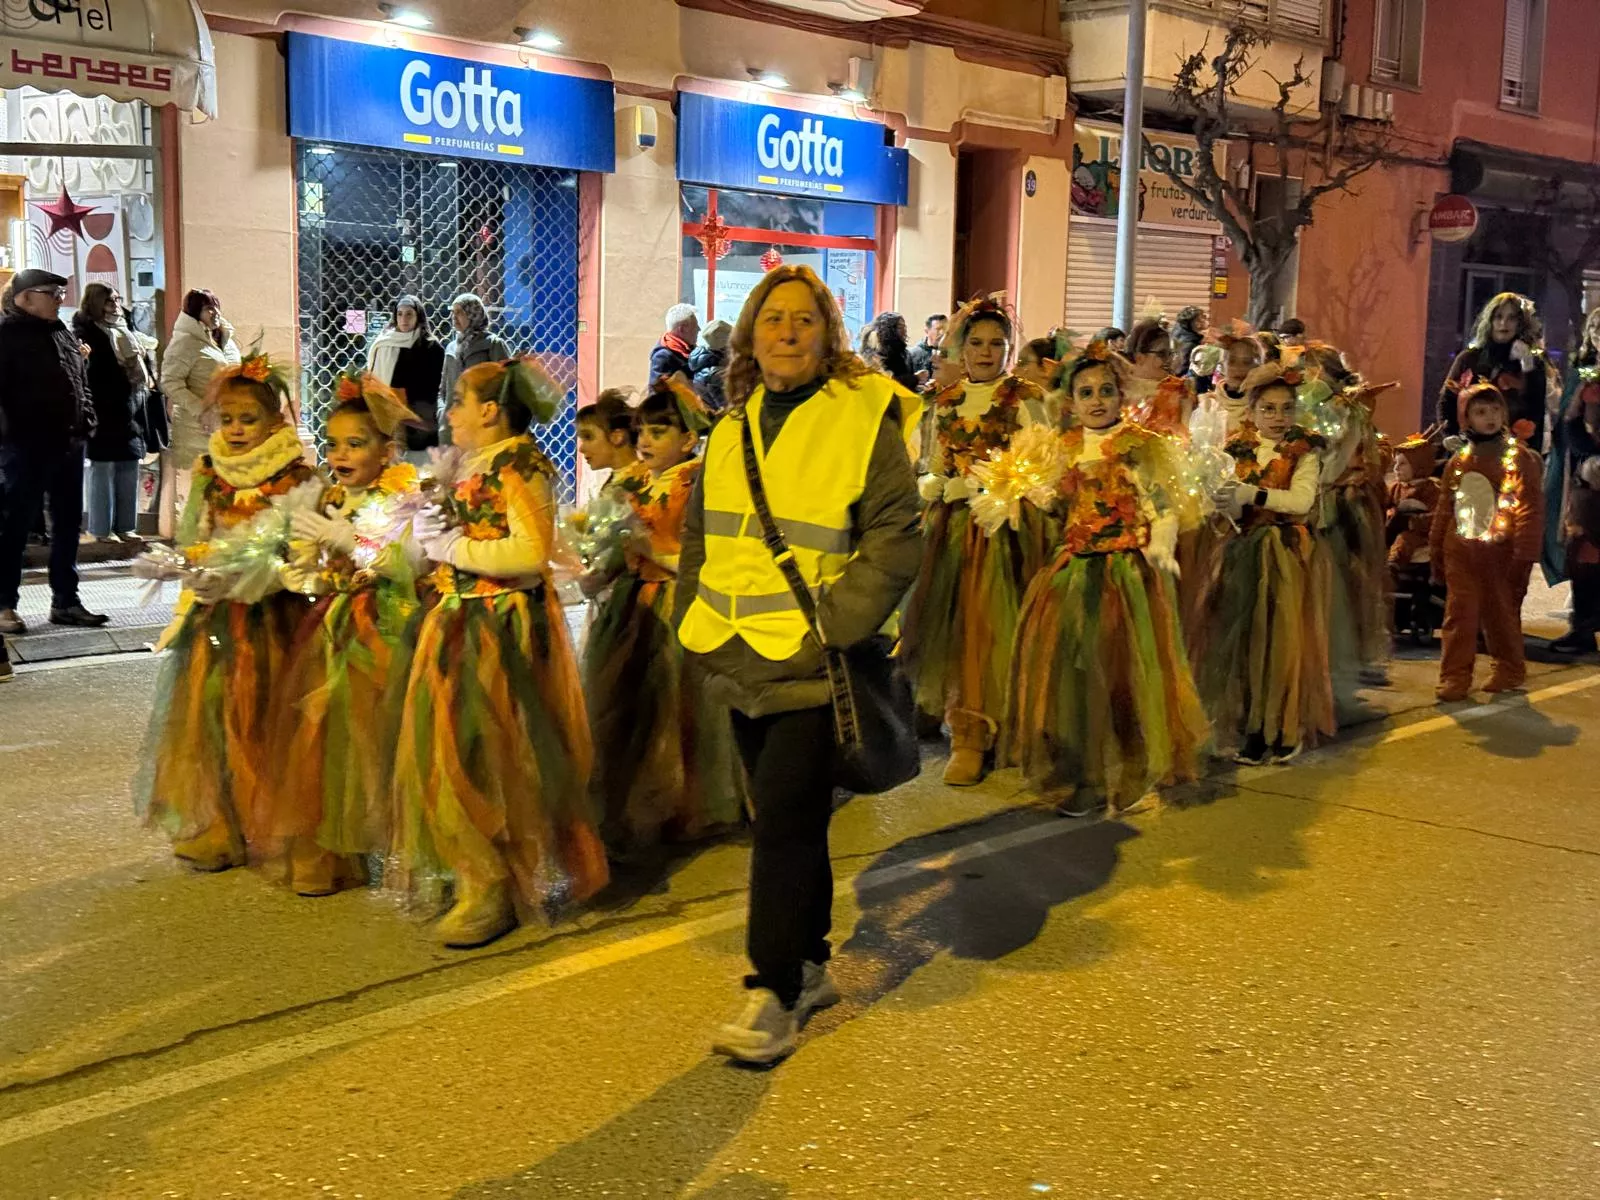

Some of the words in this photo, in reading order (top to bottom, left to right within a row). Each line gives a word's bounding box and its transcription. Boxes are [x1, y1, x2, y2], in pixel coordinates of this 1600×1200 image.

[401, 59, 523, 137] Gotta
[435, 136, 495, 152] PERFUMERÍAS
[758, 113, 843, 177] Gotta
[1151, 181, 1186, 200] frutas
